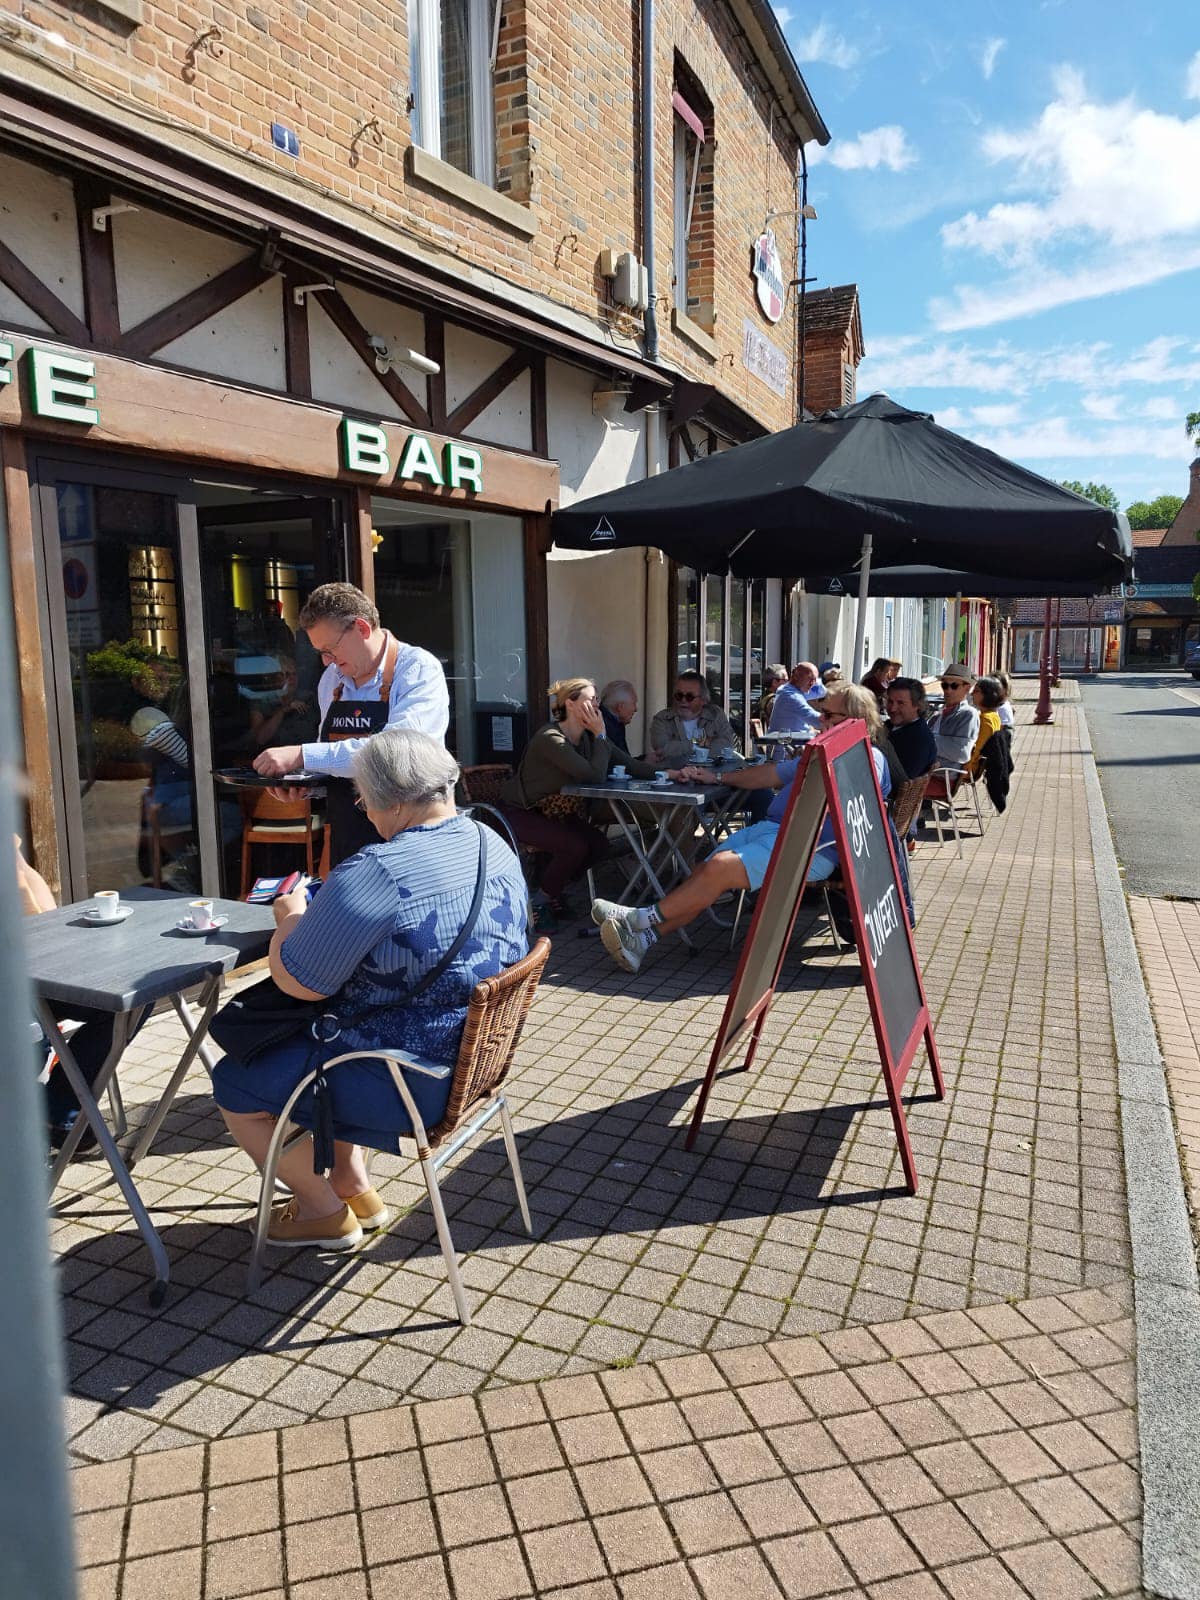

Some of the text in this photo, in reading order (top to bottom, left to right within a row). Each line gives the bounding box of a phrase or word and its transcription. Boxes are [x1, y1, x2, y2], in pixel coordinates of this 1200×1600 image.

[283, 130, 290, 152] 1
[0, 341, 483, 493] E BAR
[331, 713, 371, 728] MONIN
[847, 793, 873, 858] BAR
